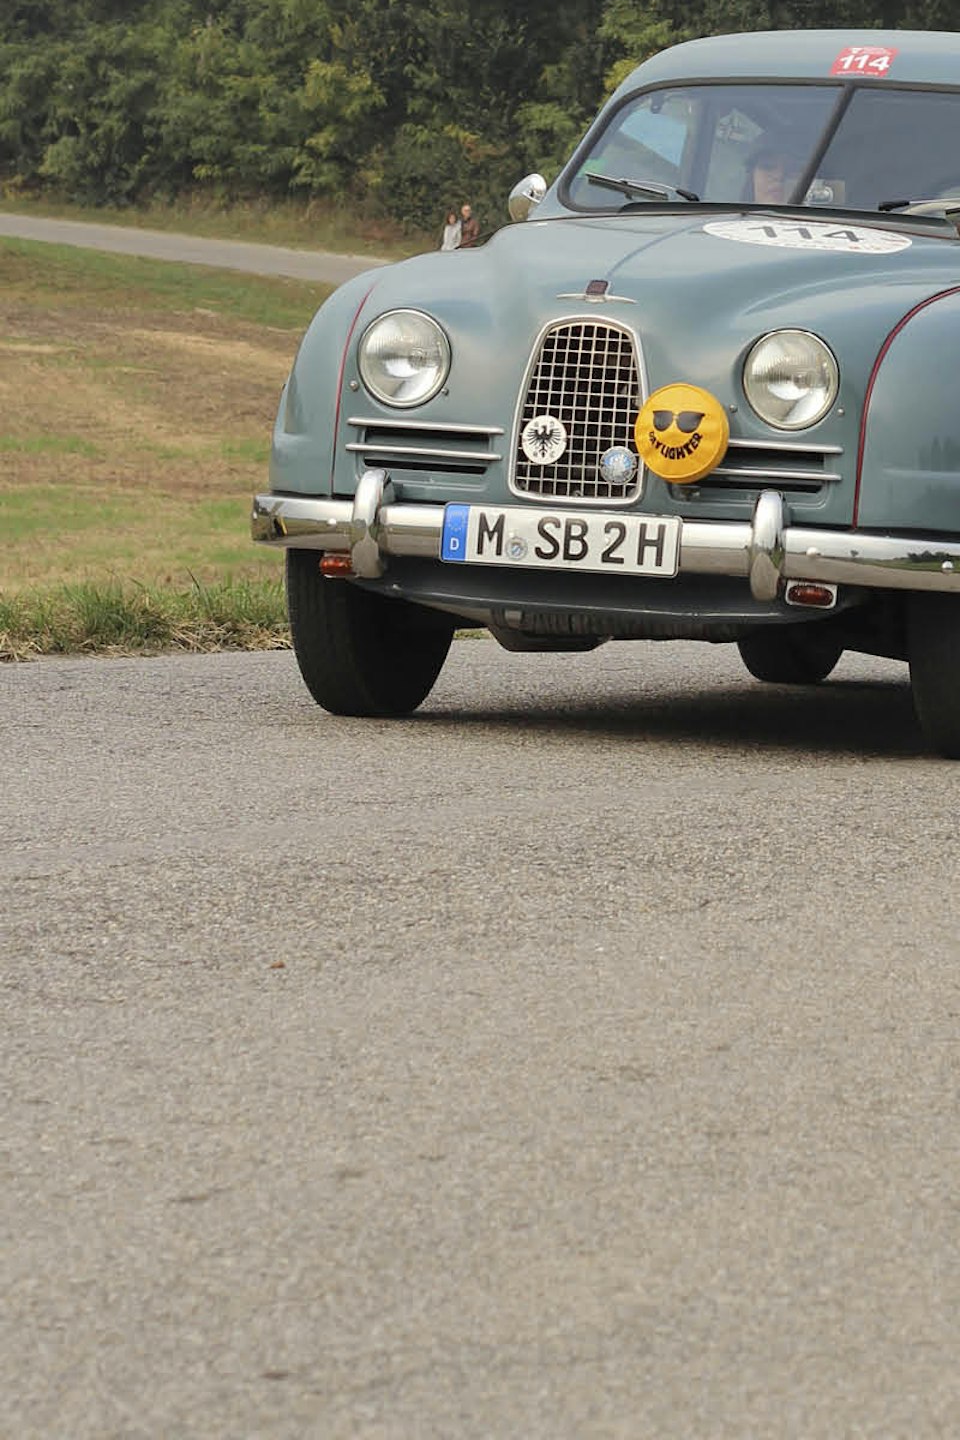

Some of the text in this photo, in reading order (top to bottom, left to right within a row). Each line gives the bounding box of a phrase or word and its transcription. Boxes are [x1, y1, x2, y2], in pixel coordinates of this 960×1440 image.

[840, 54, 890, 71] 114
[747, 226, 865, 243] 114
[476, 512, 506, 557] M
[450, 538, 460, 551] D
